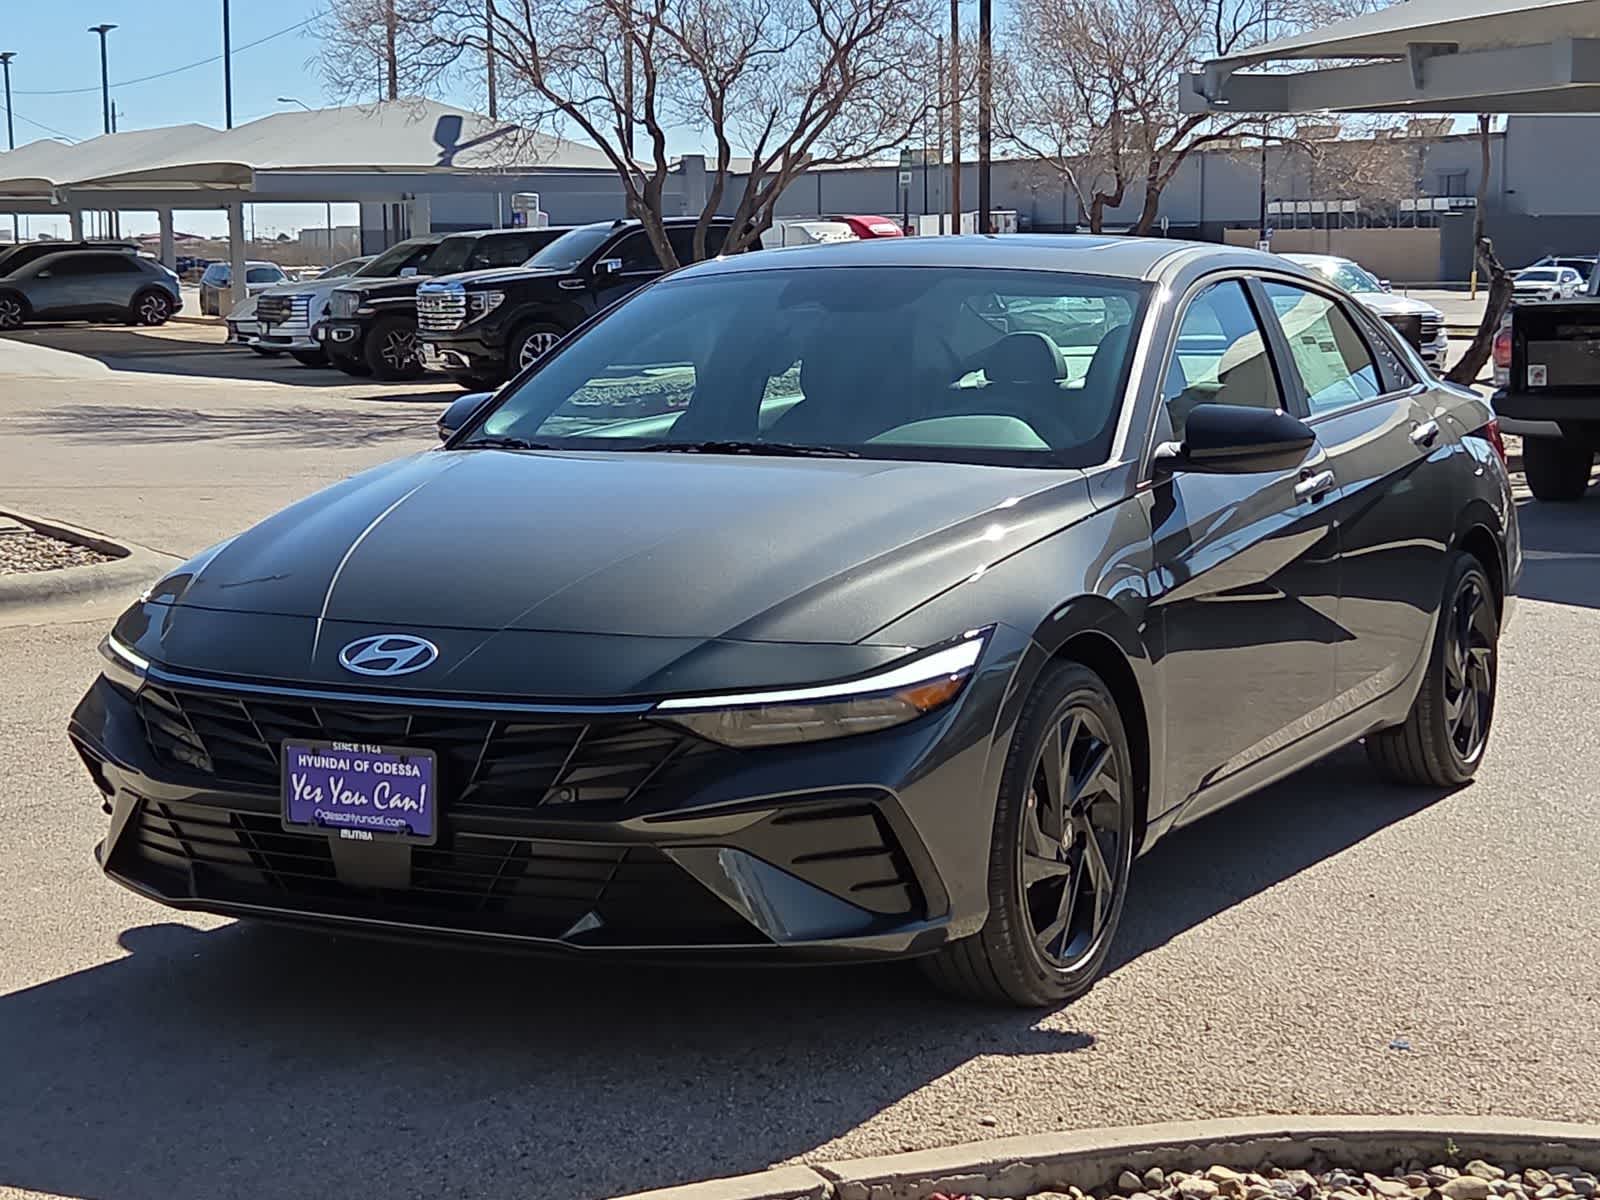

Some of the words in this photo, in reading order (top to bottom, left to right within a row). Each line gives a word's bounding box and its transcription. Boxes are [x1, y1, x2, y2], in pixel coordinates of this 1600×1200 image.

[332, 741, 359, 752] SINCE
[298, 754, 350, 771] HYUNDAI
[353, 759, 370, 772] OF
[373, 762, 421, 777] ODESSA
[291, 773, 323, 803] Yes
[329, 776, 368, 805] You
[374, 782, 427, 814] Can!
